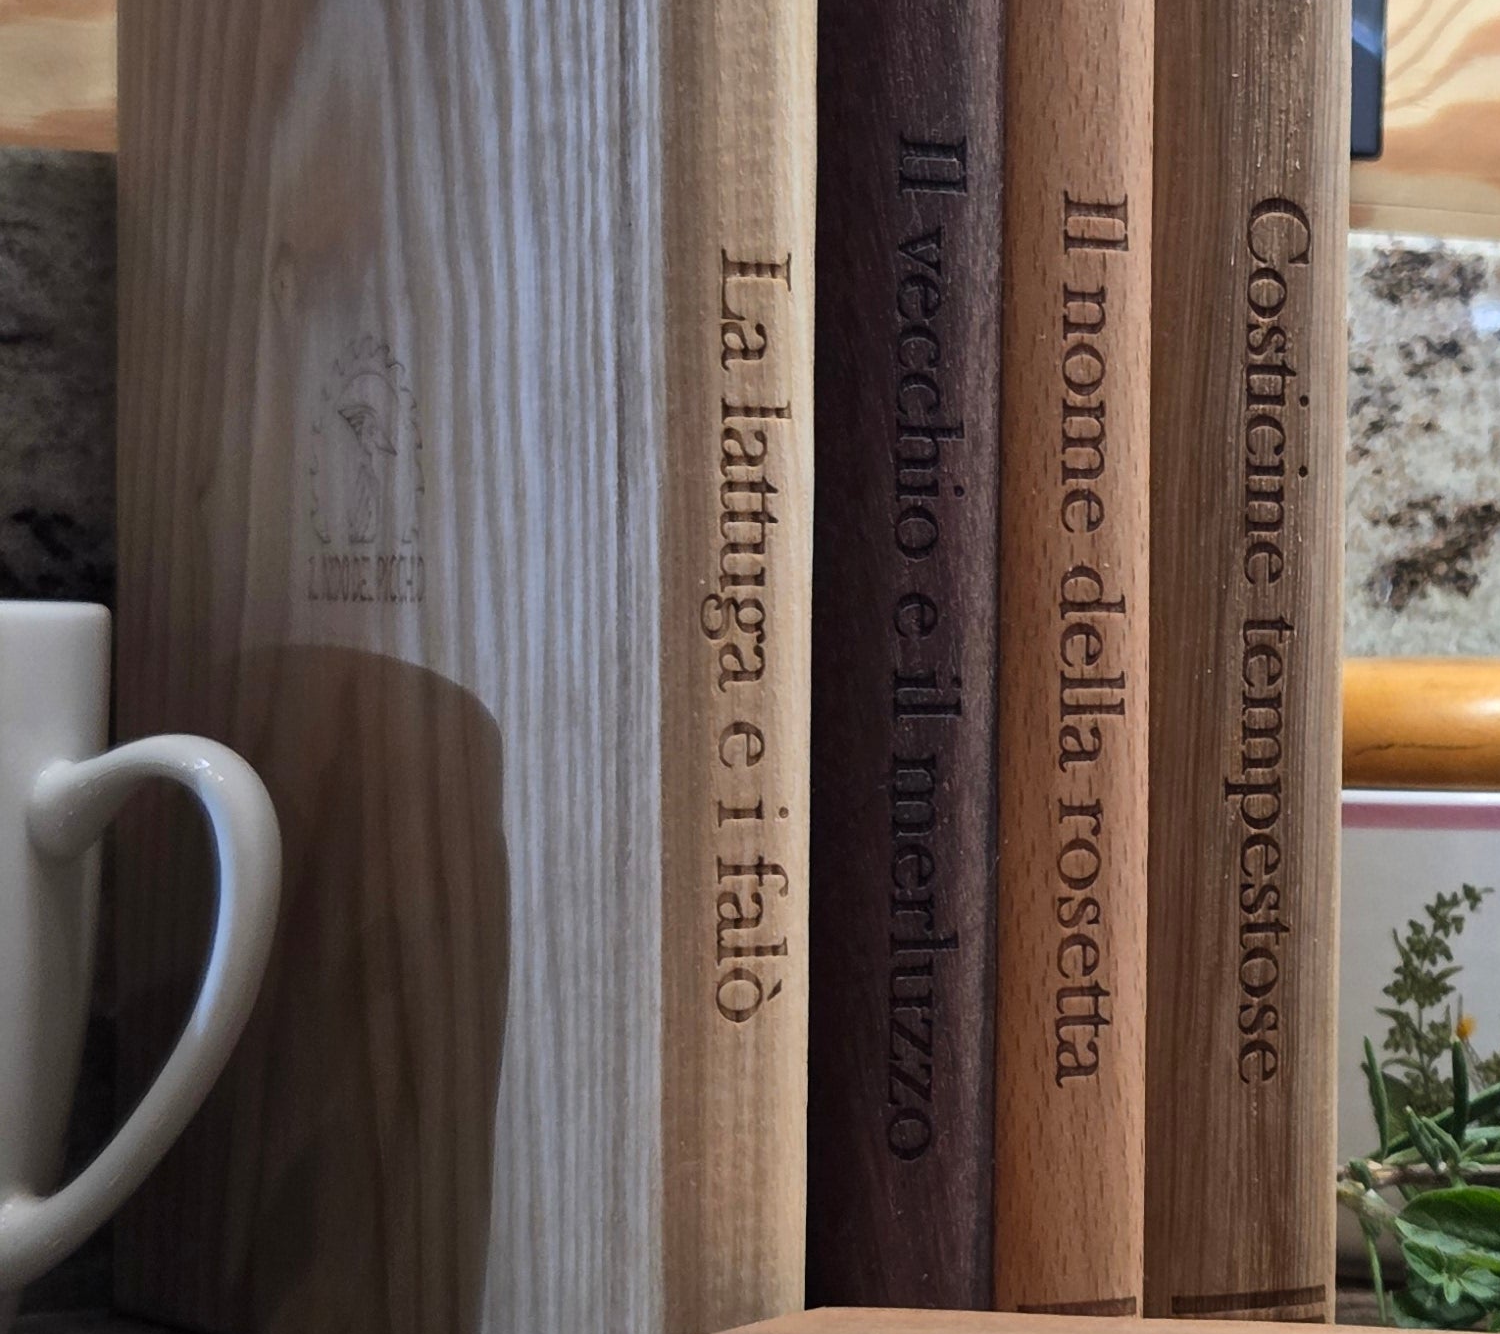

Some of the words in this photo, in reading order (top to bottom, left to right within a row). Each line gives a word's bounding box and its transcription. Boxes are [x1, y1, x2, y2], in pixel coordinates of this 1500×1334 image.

[900, 135, 968, 195] Il
[1062, 189, 1130, 255] Il
[719, 247, 792, 372] La
[894, 226, 966, 561] vecchio
[1242, 195, 1312, 587] Costicine
[1059, 281, 1107, 535] nome
[701, 396, 793, 695] lattuga
[894, 591, 940, 641] e
[717, 720, 767, 770] e
[892, 670, 963, 721] il
[1056, 562, 1127, 774] della
[716, 797, 790, 829] i
[1223, 614, 1295, 1086] tempestose
[714, 854, 790, 1024] falò
[887, 752, 960, 1162] merluzzo
[1054, 796, 1112, 1090] rosetta
